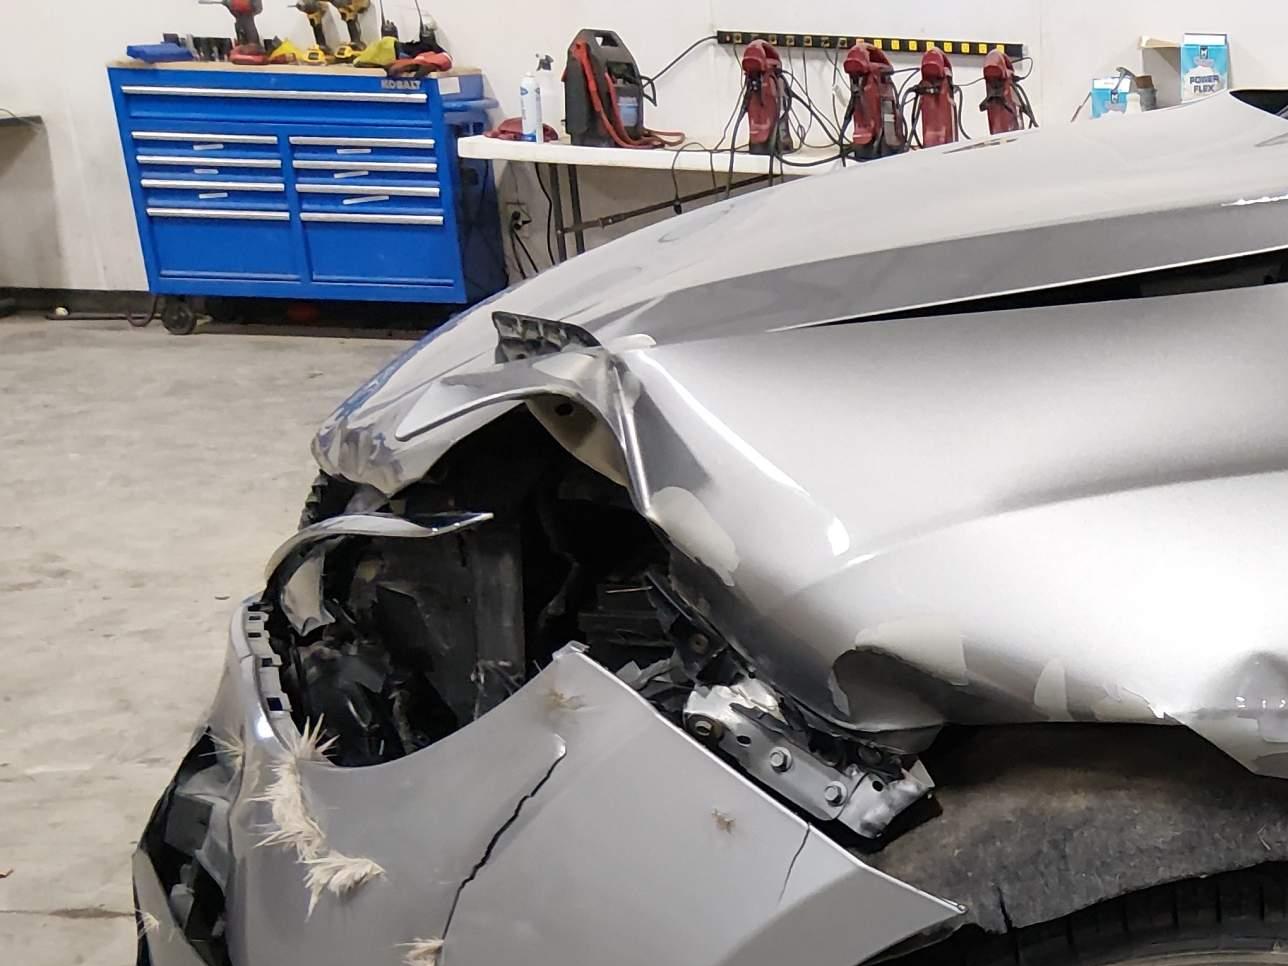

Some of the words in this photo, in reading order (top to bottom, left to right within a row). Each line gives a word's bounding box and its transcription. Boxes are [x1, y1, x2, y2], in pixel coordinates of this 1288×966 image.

[1189, 74, 1219, 84] POWER
[381, 79, 421, 90] KOBALT
[1193, 84, 1216, 94] FLEX
